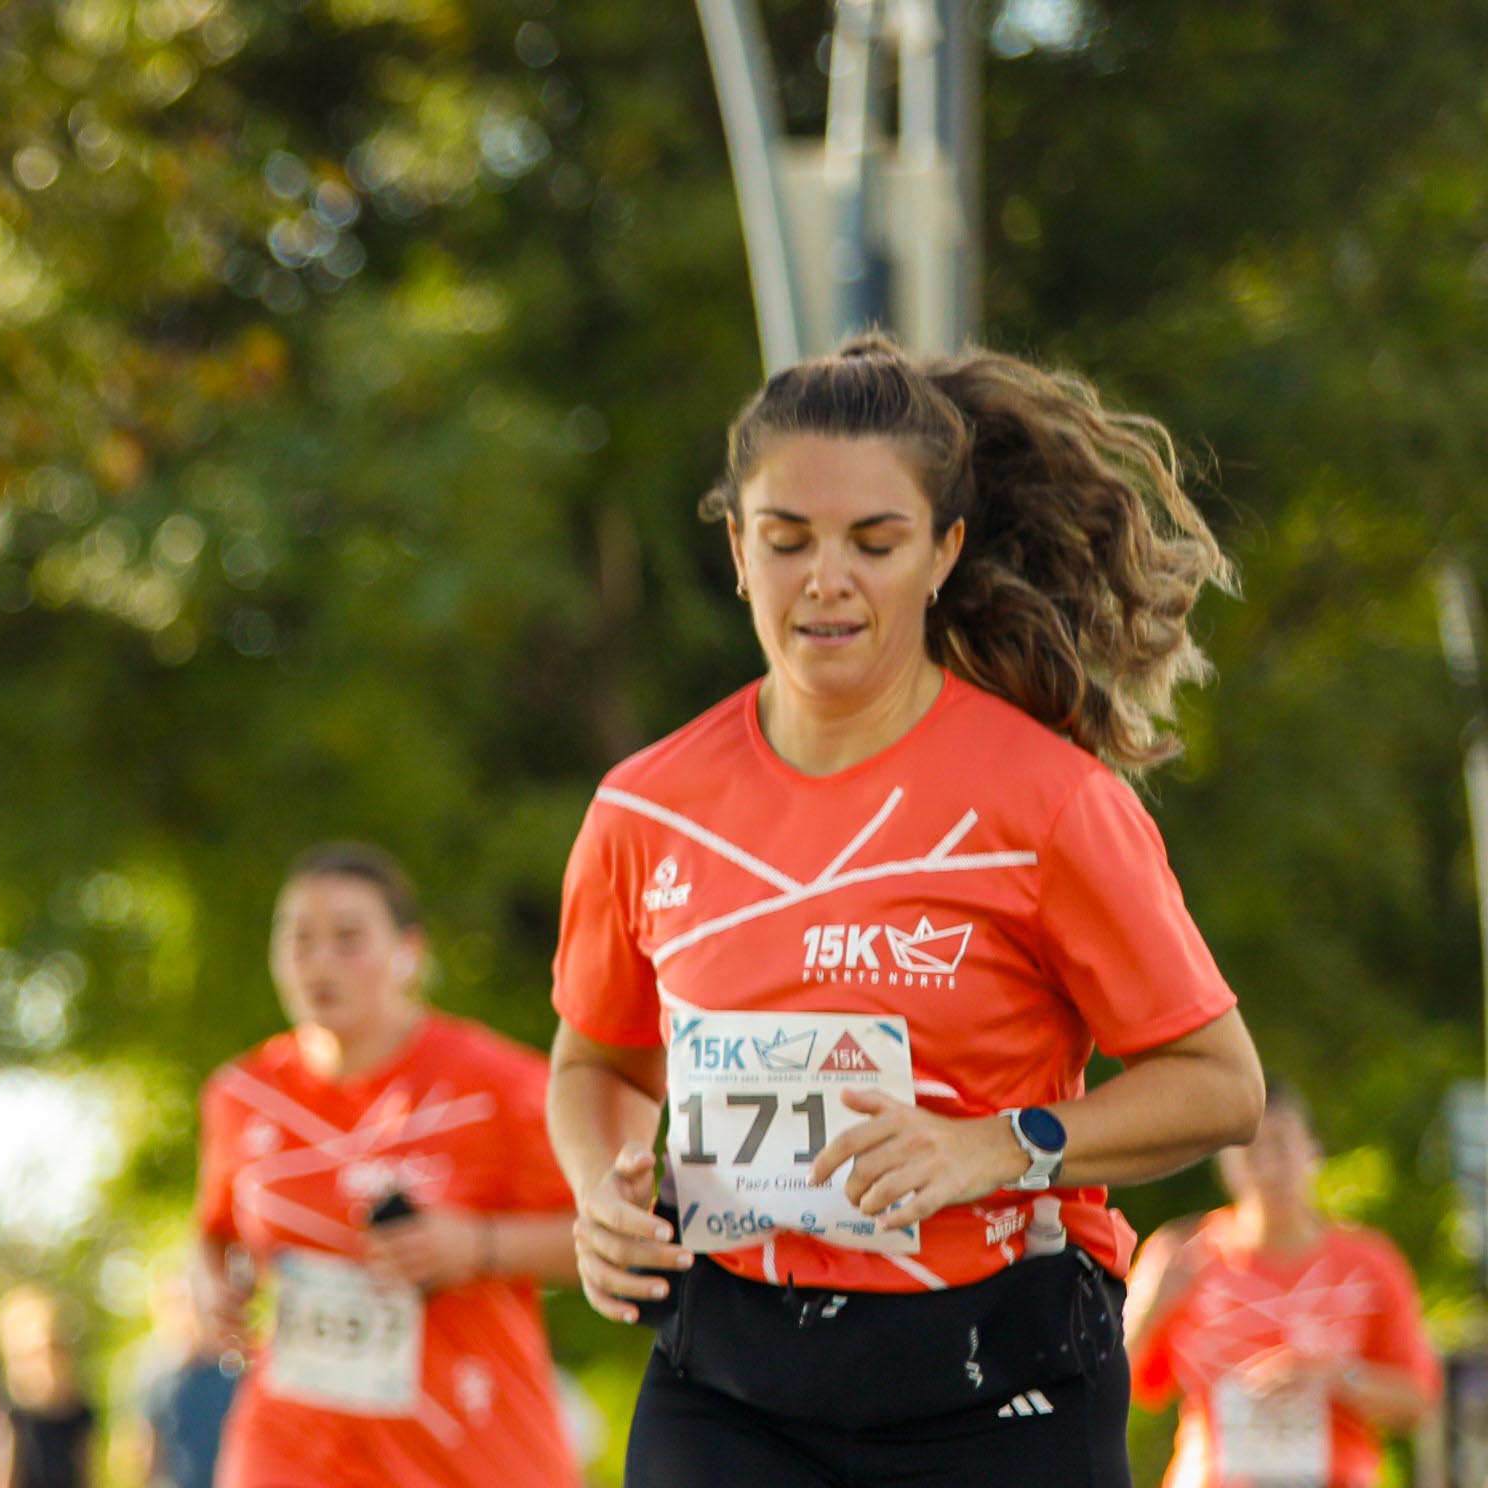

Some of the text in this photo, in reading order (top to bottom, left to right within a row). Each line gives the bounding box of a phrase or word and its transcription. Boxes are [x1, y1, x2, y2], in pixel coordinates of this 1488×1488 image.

[803, 924, 882, 970] 15K
[690, 1036, 747, 1071] 15K
[830, 1047, 866, 1070] 15K
